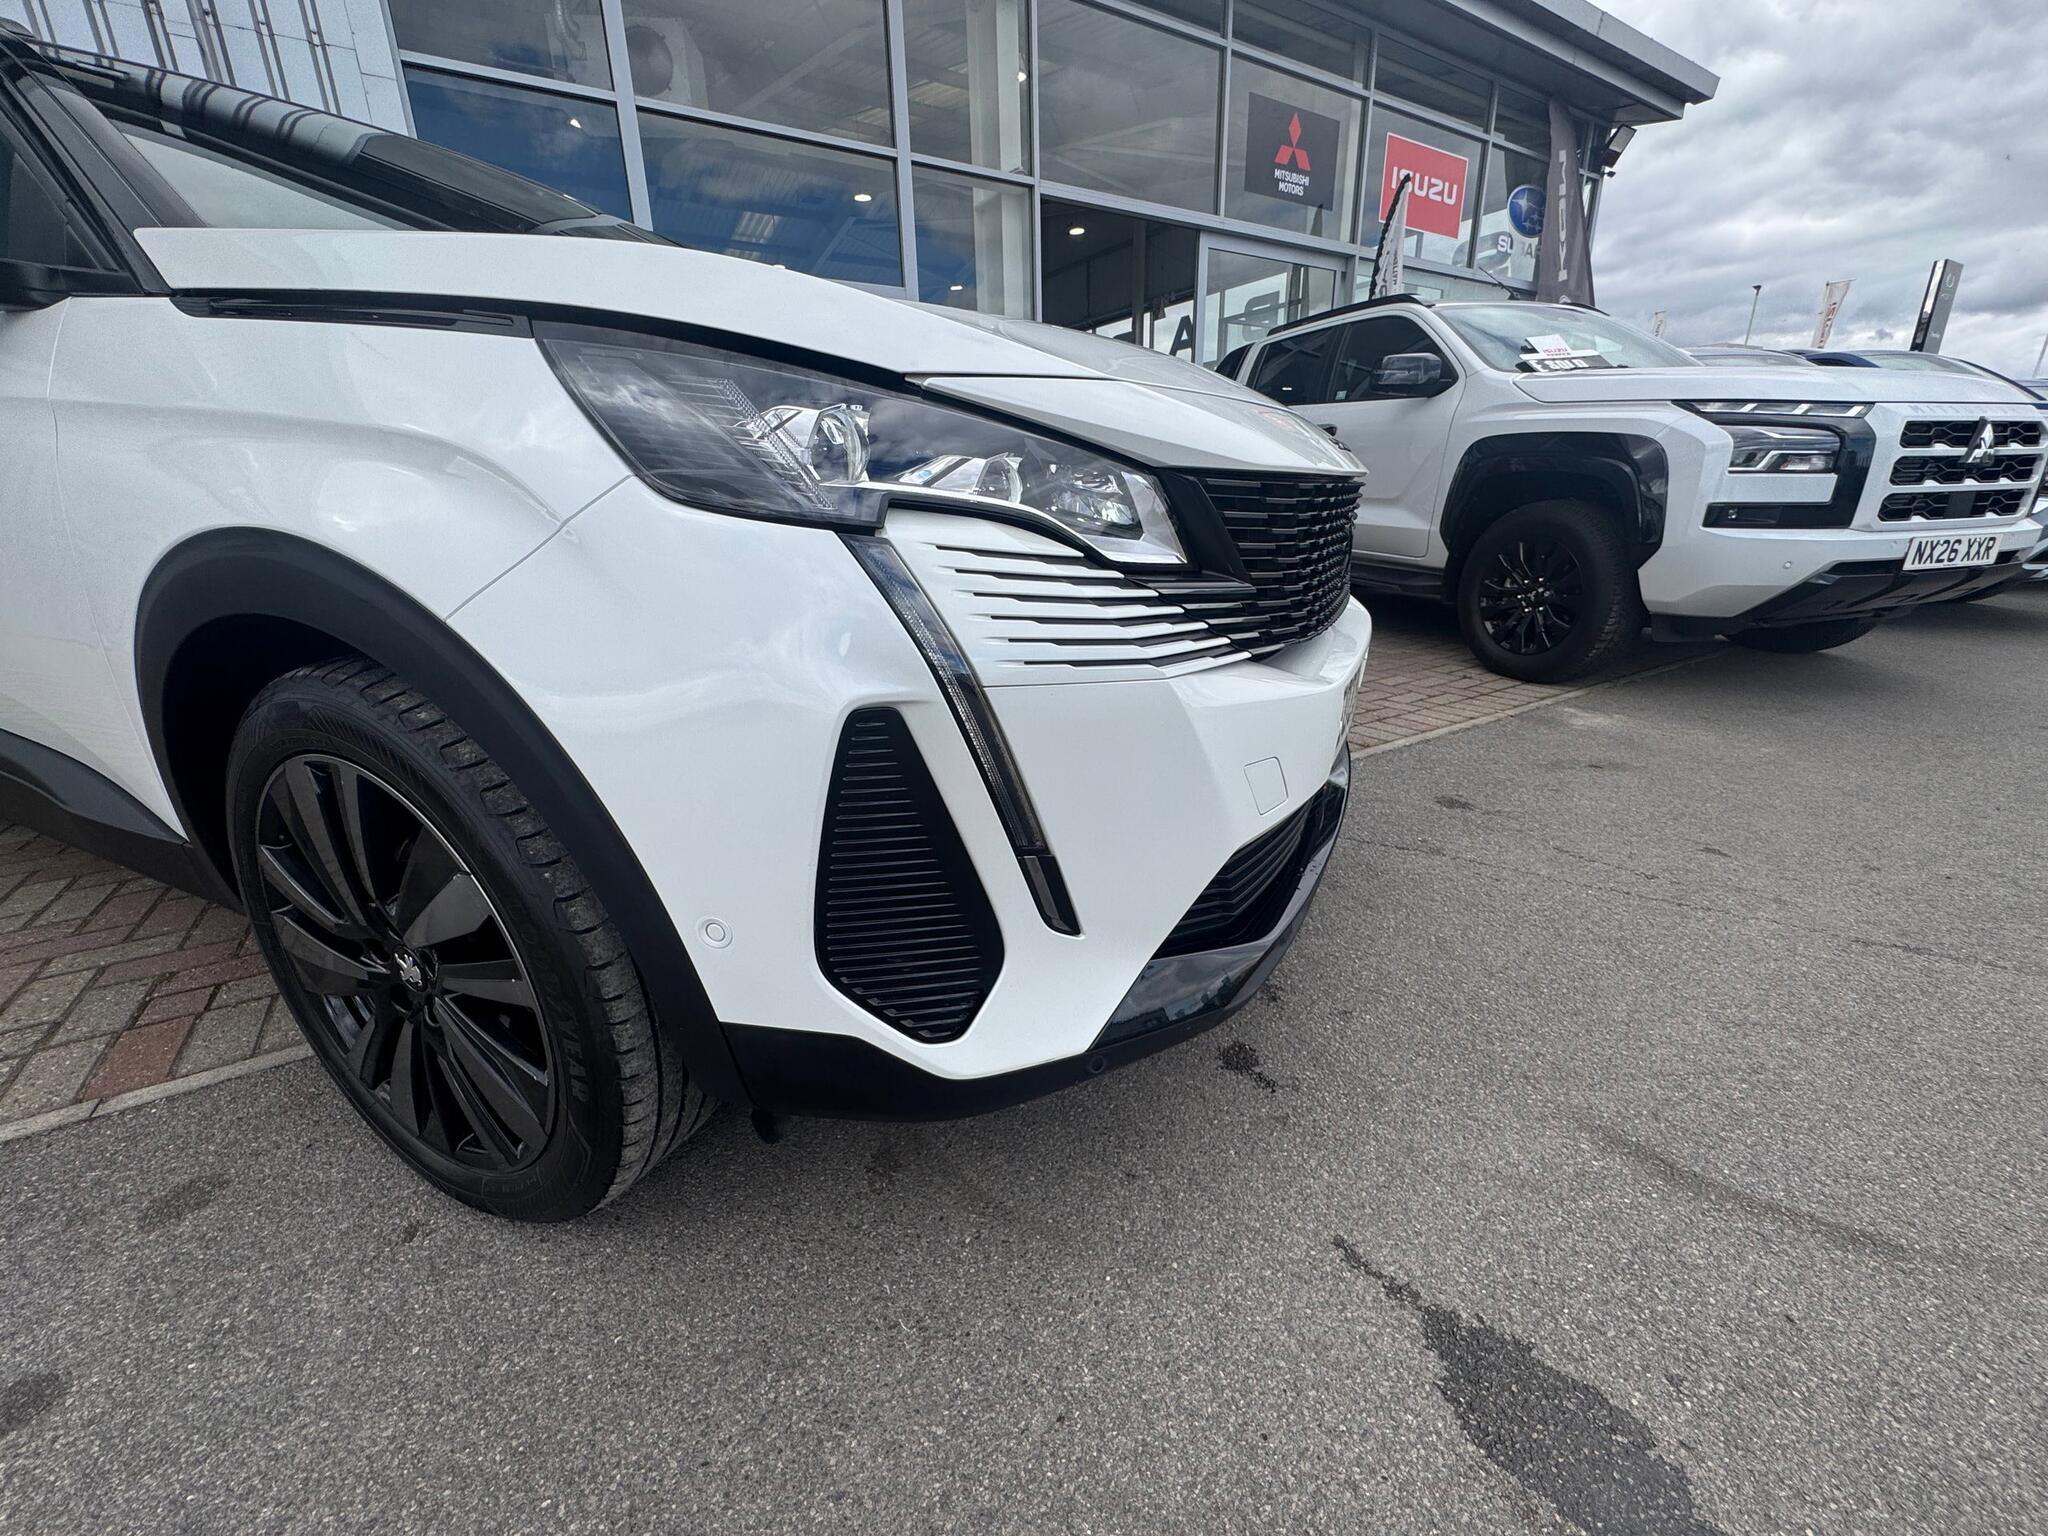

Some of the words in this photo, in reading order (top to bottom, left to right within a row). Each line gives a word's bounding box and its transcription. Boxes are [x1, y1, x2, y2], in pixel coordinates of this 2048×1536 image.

[1274, 168, 1310, 187] MITSUBISHI
[1278, 181, 1304, 197] MOTORS
[1391, 166, 1458, 205] ISUZU
[1911, 538, 1962, 566] NX26
[1960, 536, 1997, 563] XXR
